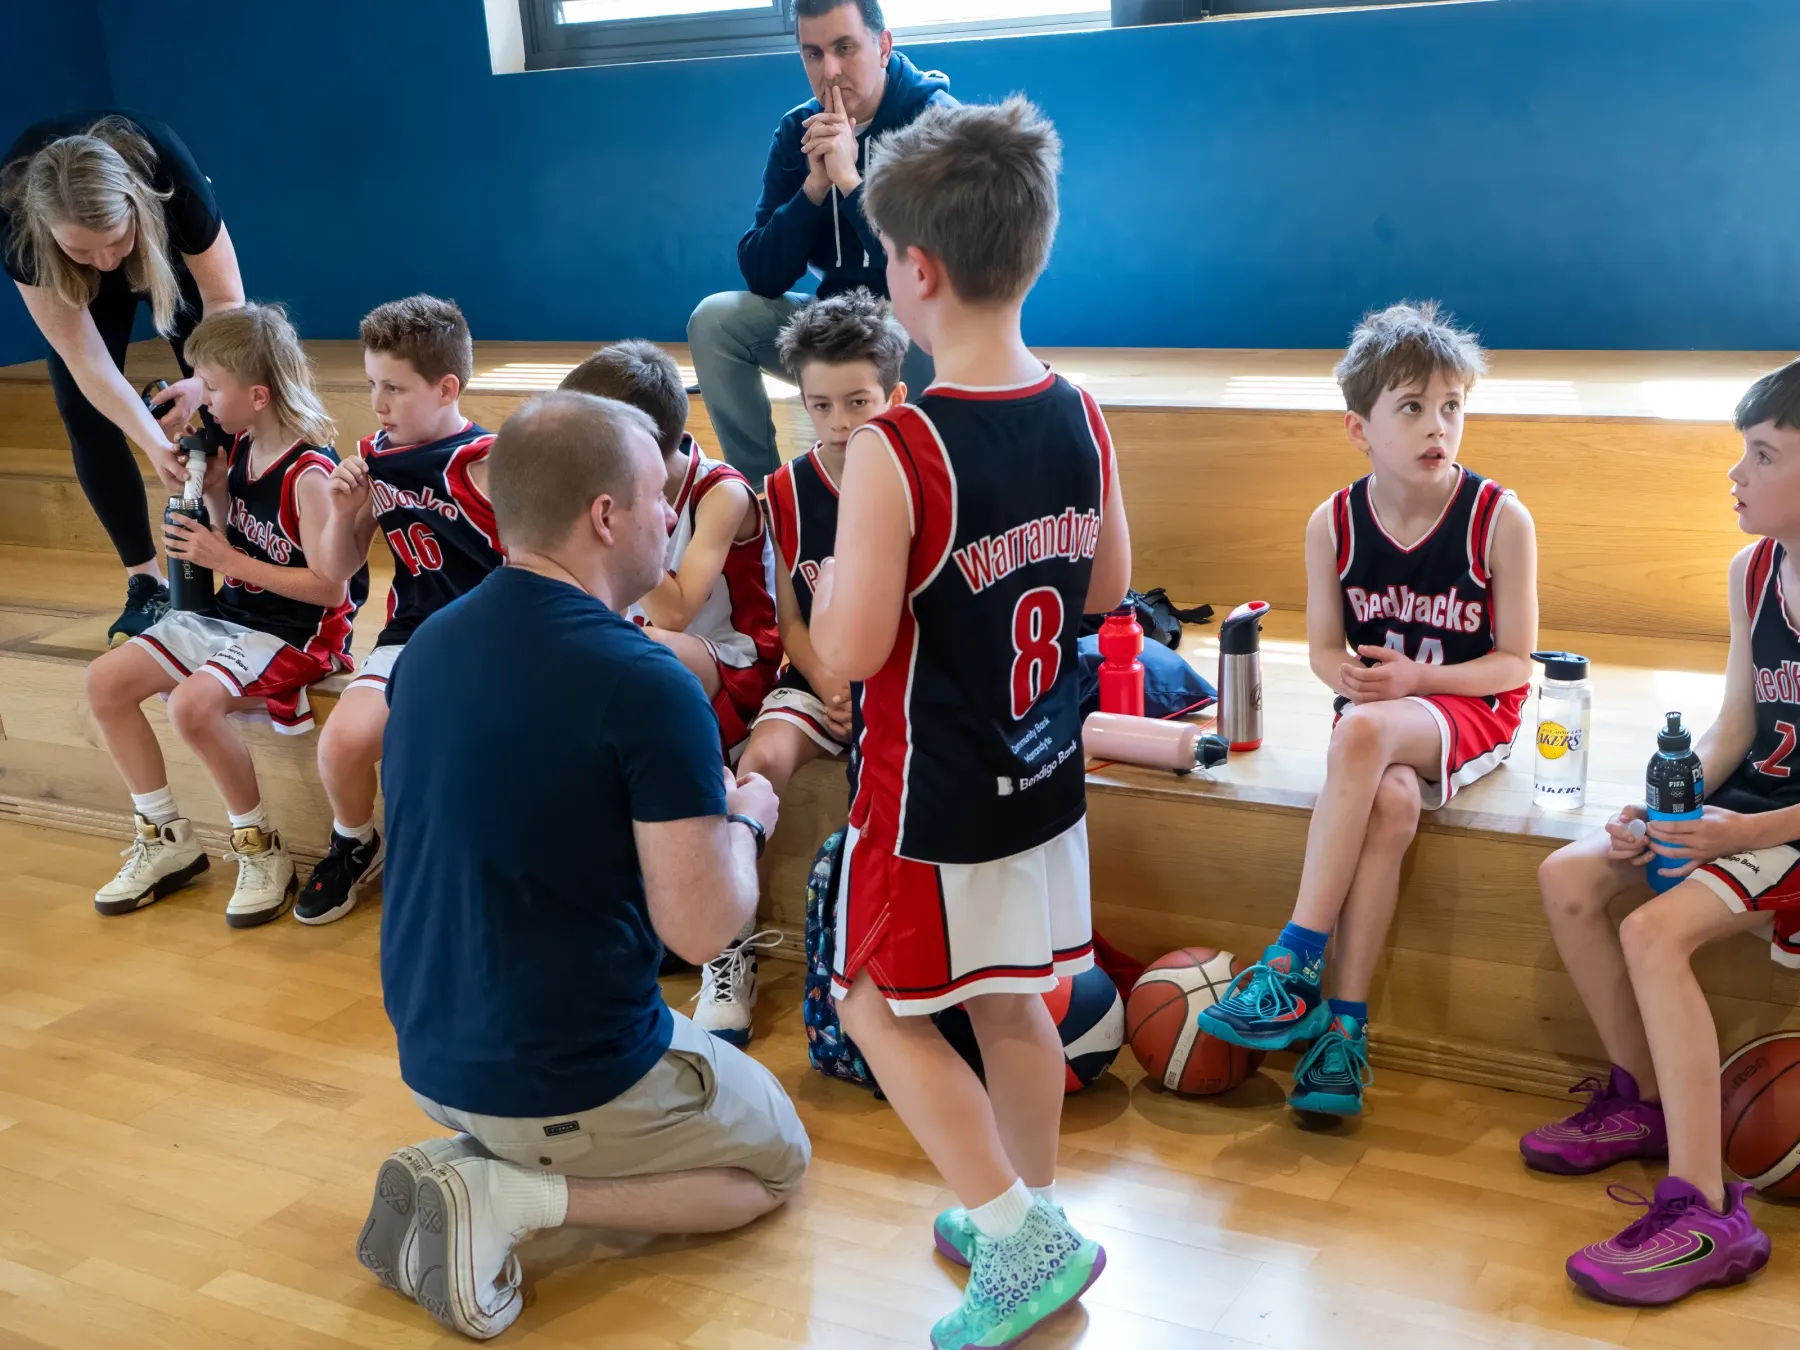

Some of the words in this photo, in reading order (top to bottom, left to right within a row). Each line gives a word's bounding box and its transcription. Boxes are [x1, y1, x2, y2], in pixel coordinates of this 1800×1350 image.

[952, 507, 1100, 595] Warrandyte
[1346, 584, 1482, 633] Redbacks
[1010, 586, 1064, 721] 8
[1034, 716, 1051, 733] Bank
[1020, 760, 1058, 791] Bendigo
[1058, 740, 1077, 765] Bank
[1668, 780, 1685, 788] FIFA
[1740, 858, 1761, 875] Bank
